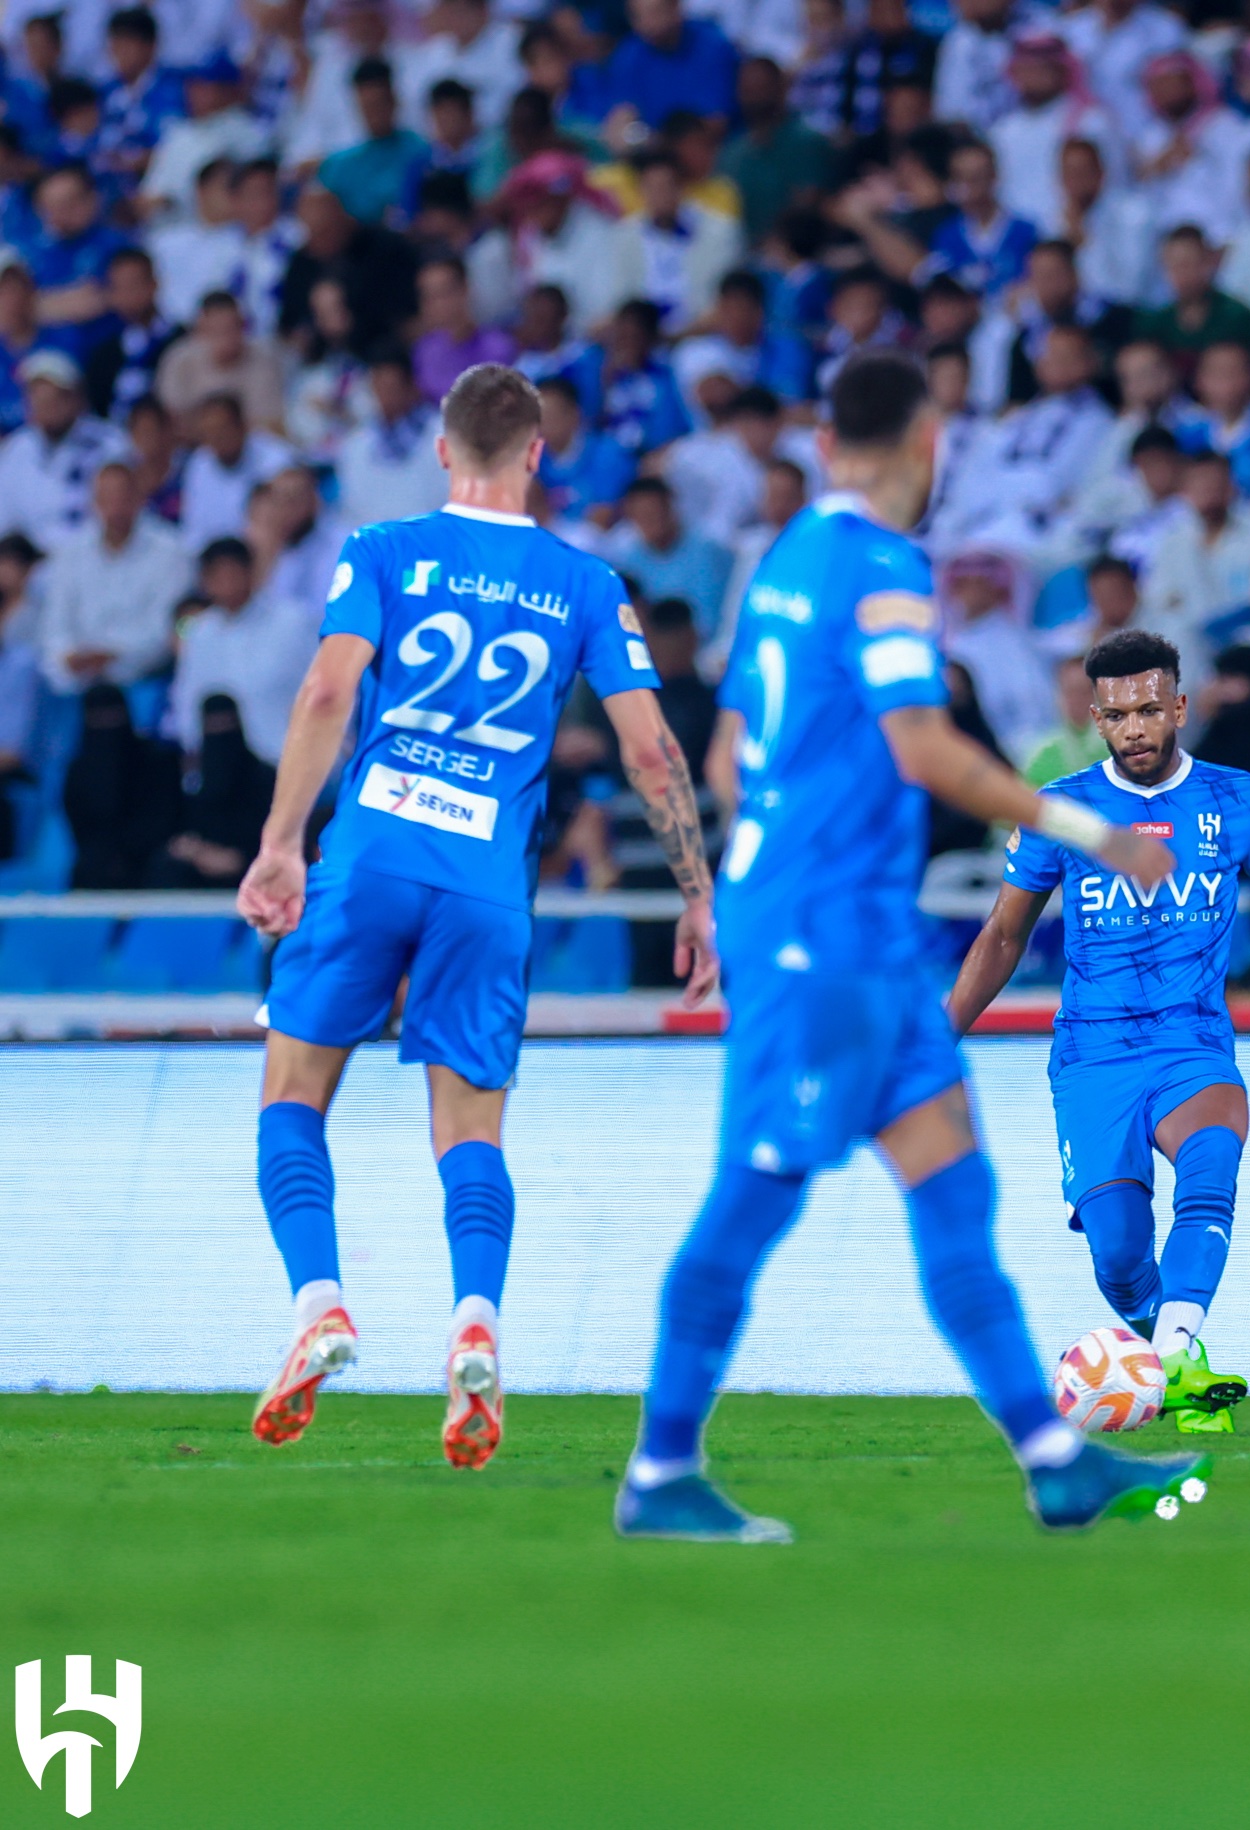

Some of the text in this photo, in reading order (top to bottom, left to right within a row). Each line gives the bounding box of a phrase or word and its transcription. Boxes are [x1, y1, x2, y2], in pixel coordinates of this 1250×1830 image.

[447, 573, 570, 626] بنك الرياض
[381, 611, 550, 753] 22
[388, 734, 495, 782] SERGEJ
[415, 792, 474, 822] SEVEN
[1080, 871, 1222, 912] SAVVY
[1084, 911, 1220, 928] GAMES GROUP
